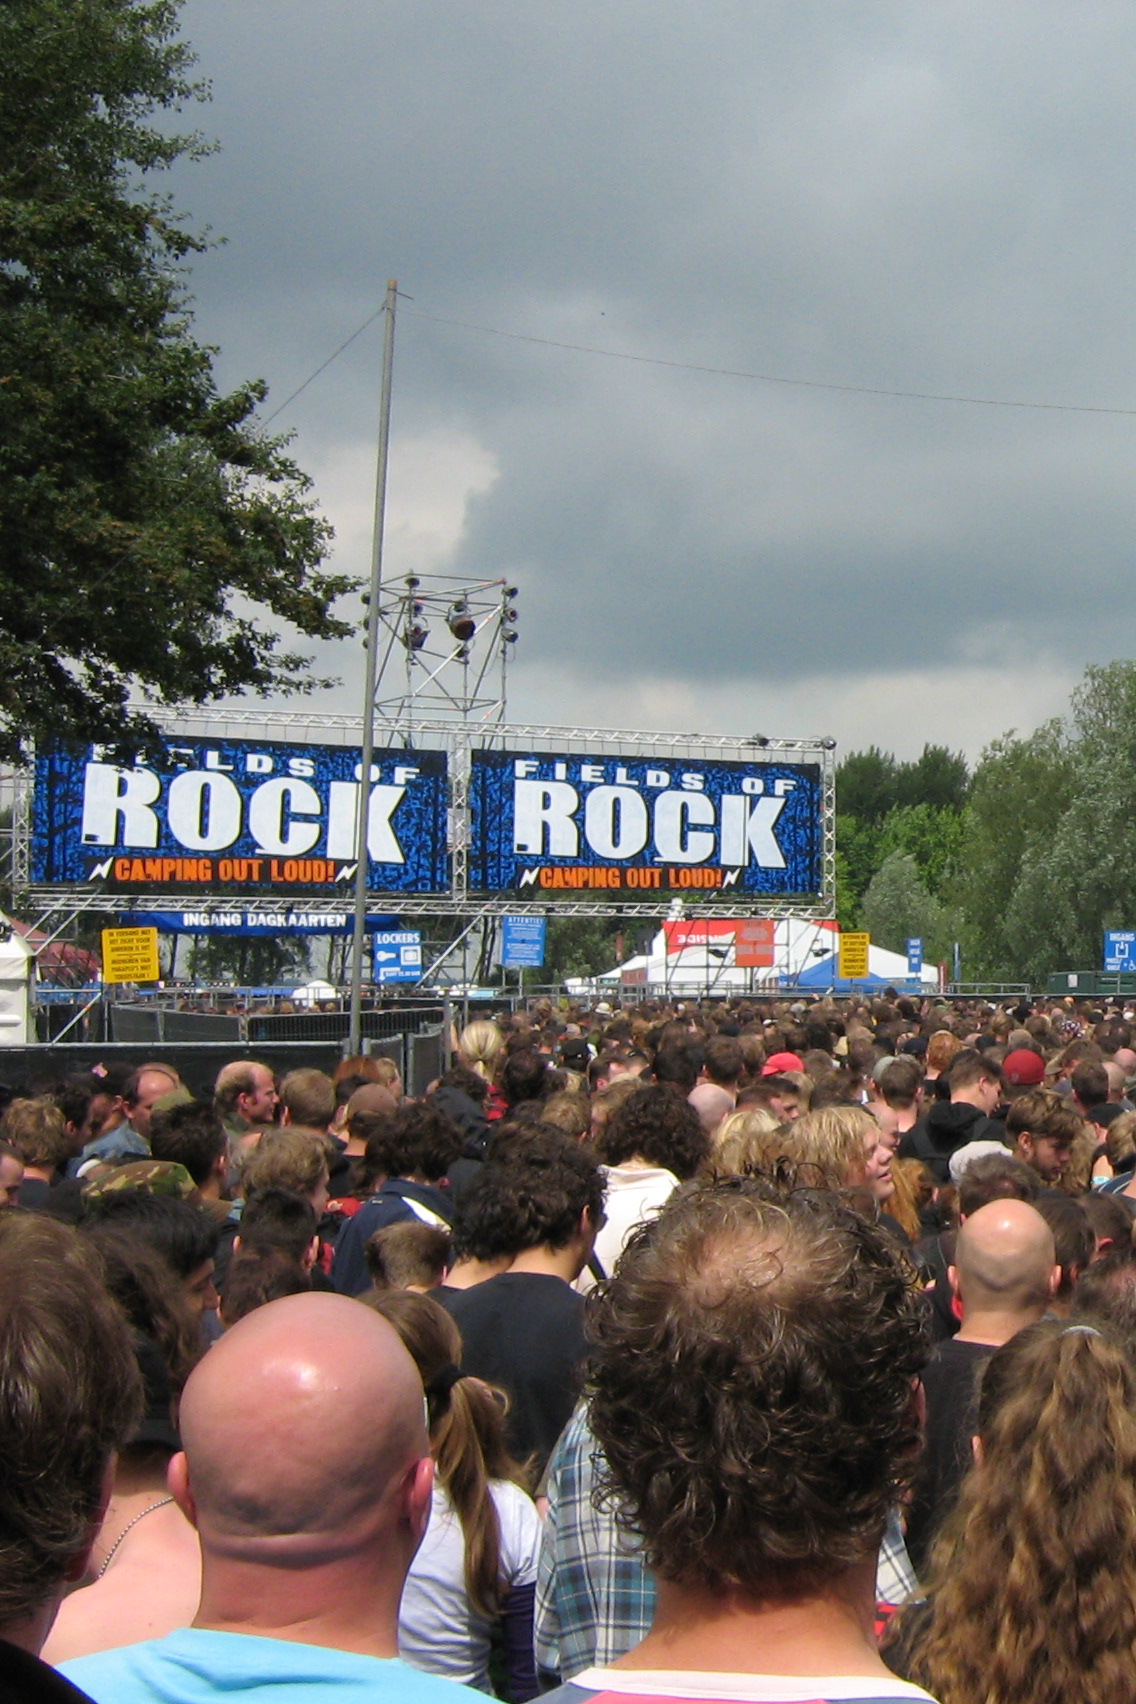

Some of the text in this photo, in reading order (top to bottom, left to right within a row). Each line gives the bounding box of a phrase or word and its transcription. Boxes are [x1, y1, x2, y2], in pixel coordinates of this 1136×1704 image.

[354, 763, 420, 785] OF
[514, 759, 797, 796] FIELDS OF
[81, 763, 407, 864] ROCK
[513, 779, 787, 868] ROCK
[114, 858, 335, 882] CAMPING OUT LOUD!
[540, 867, 722, 888] CAMPING OUT LOUD!
[183, 912, 347, 927] INGANG DAGKAARTEN
[377, 932, 420, 944] LOCKERS
